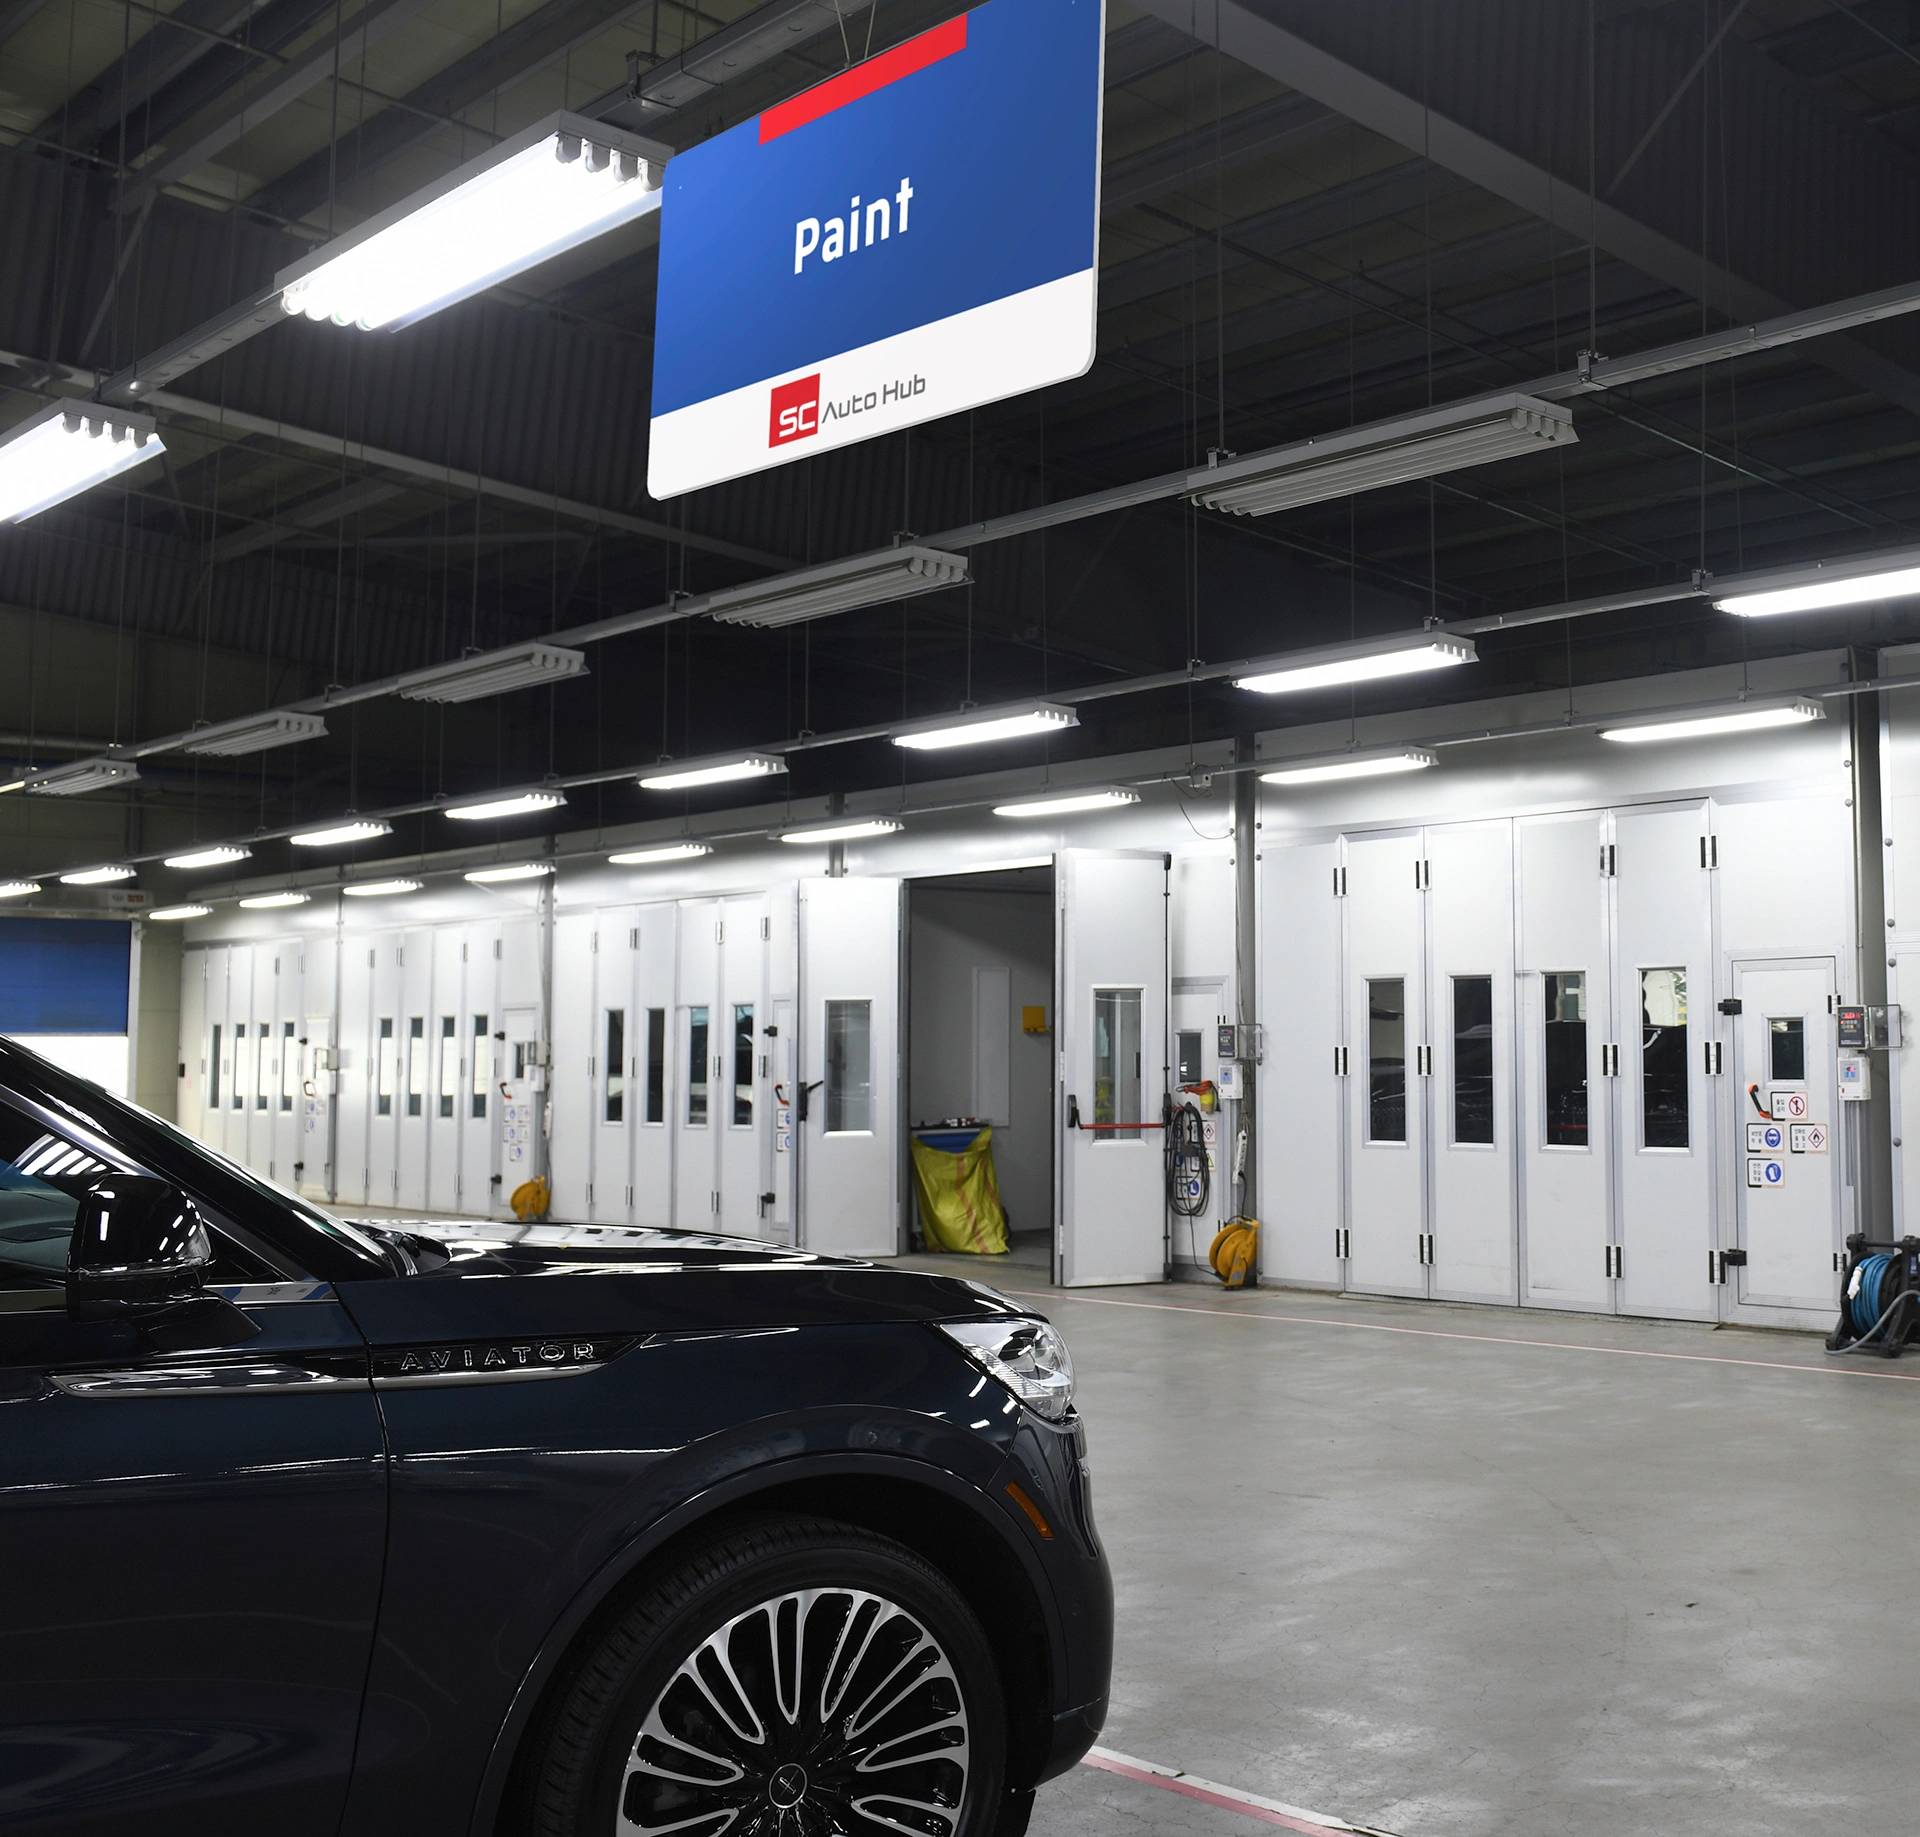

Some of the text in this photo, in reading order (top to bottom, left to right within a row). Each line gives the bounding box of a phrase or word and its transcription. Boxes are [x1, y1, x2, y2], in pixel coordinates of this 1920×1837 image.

[794, 177, 914, 275] Paint
[779, 374, 927, 439] SC Auto Hub
[400, 1342, 597, 1371] AVIATOR
